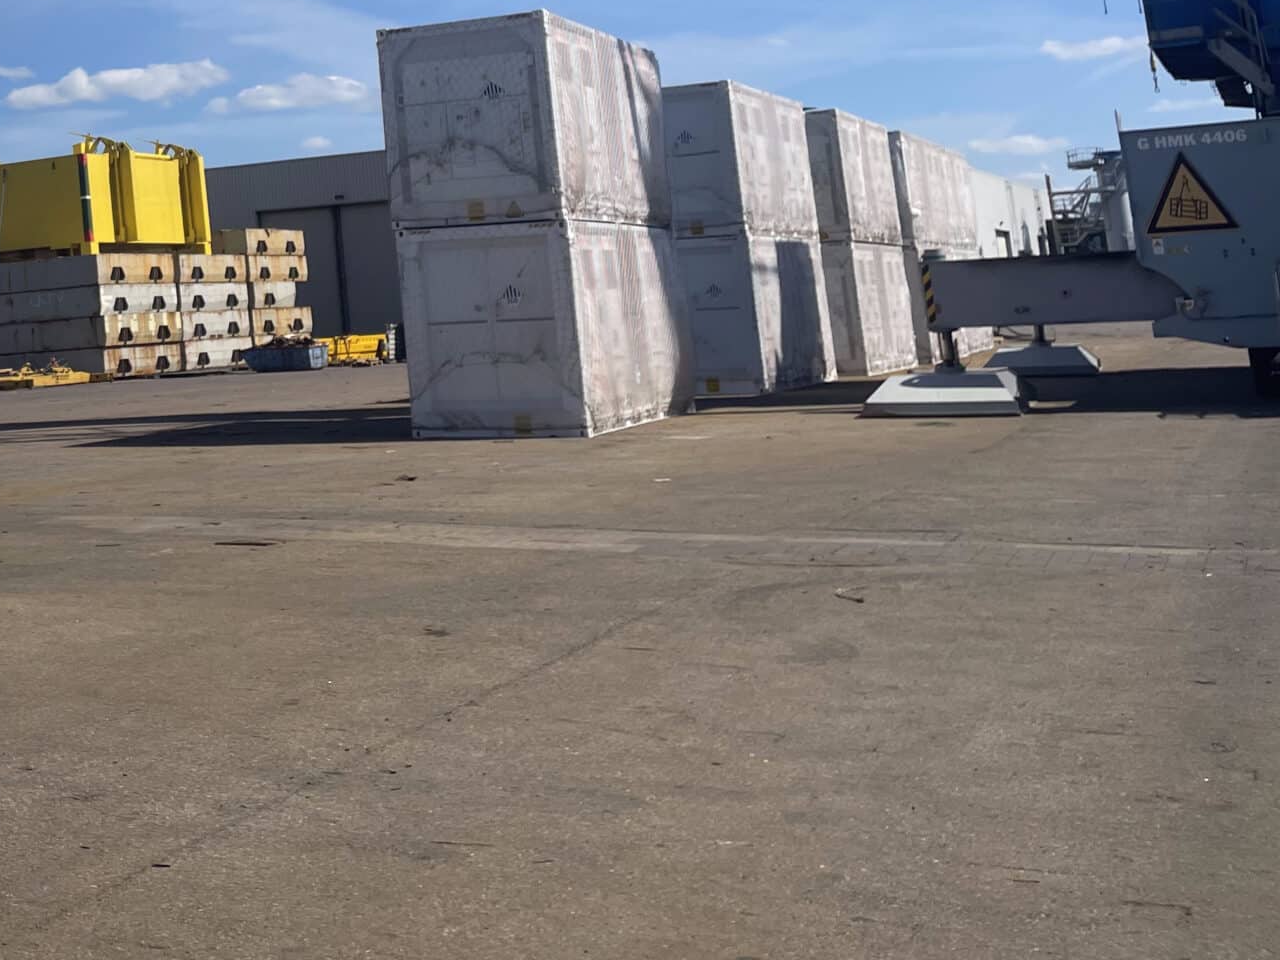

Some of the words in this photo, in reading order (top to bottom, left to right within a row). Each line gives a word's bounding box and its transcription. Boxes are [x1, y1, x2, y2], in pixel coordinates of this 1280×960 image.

[1136, 137, 1150, 150] G
[1154, 133, 1197, 149] HMK
[1201, 128, 1248, 145] 4406
